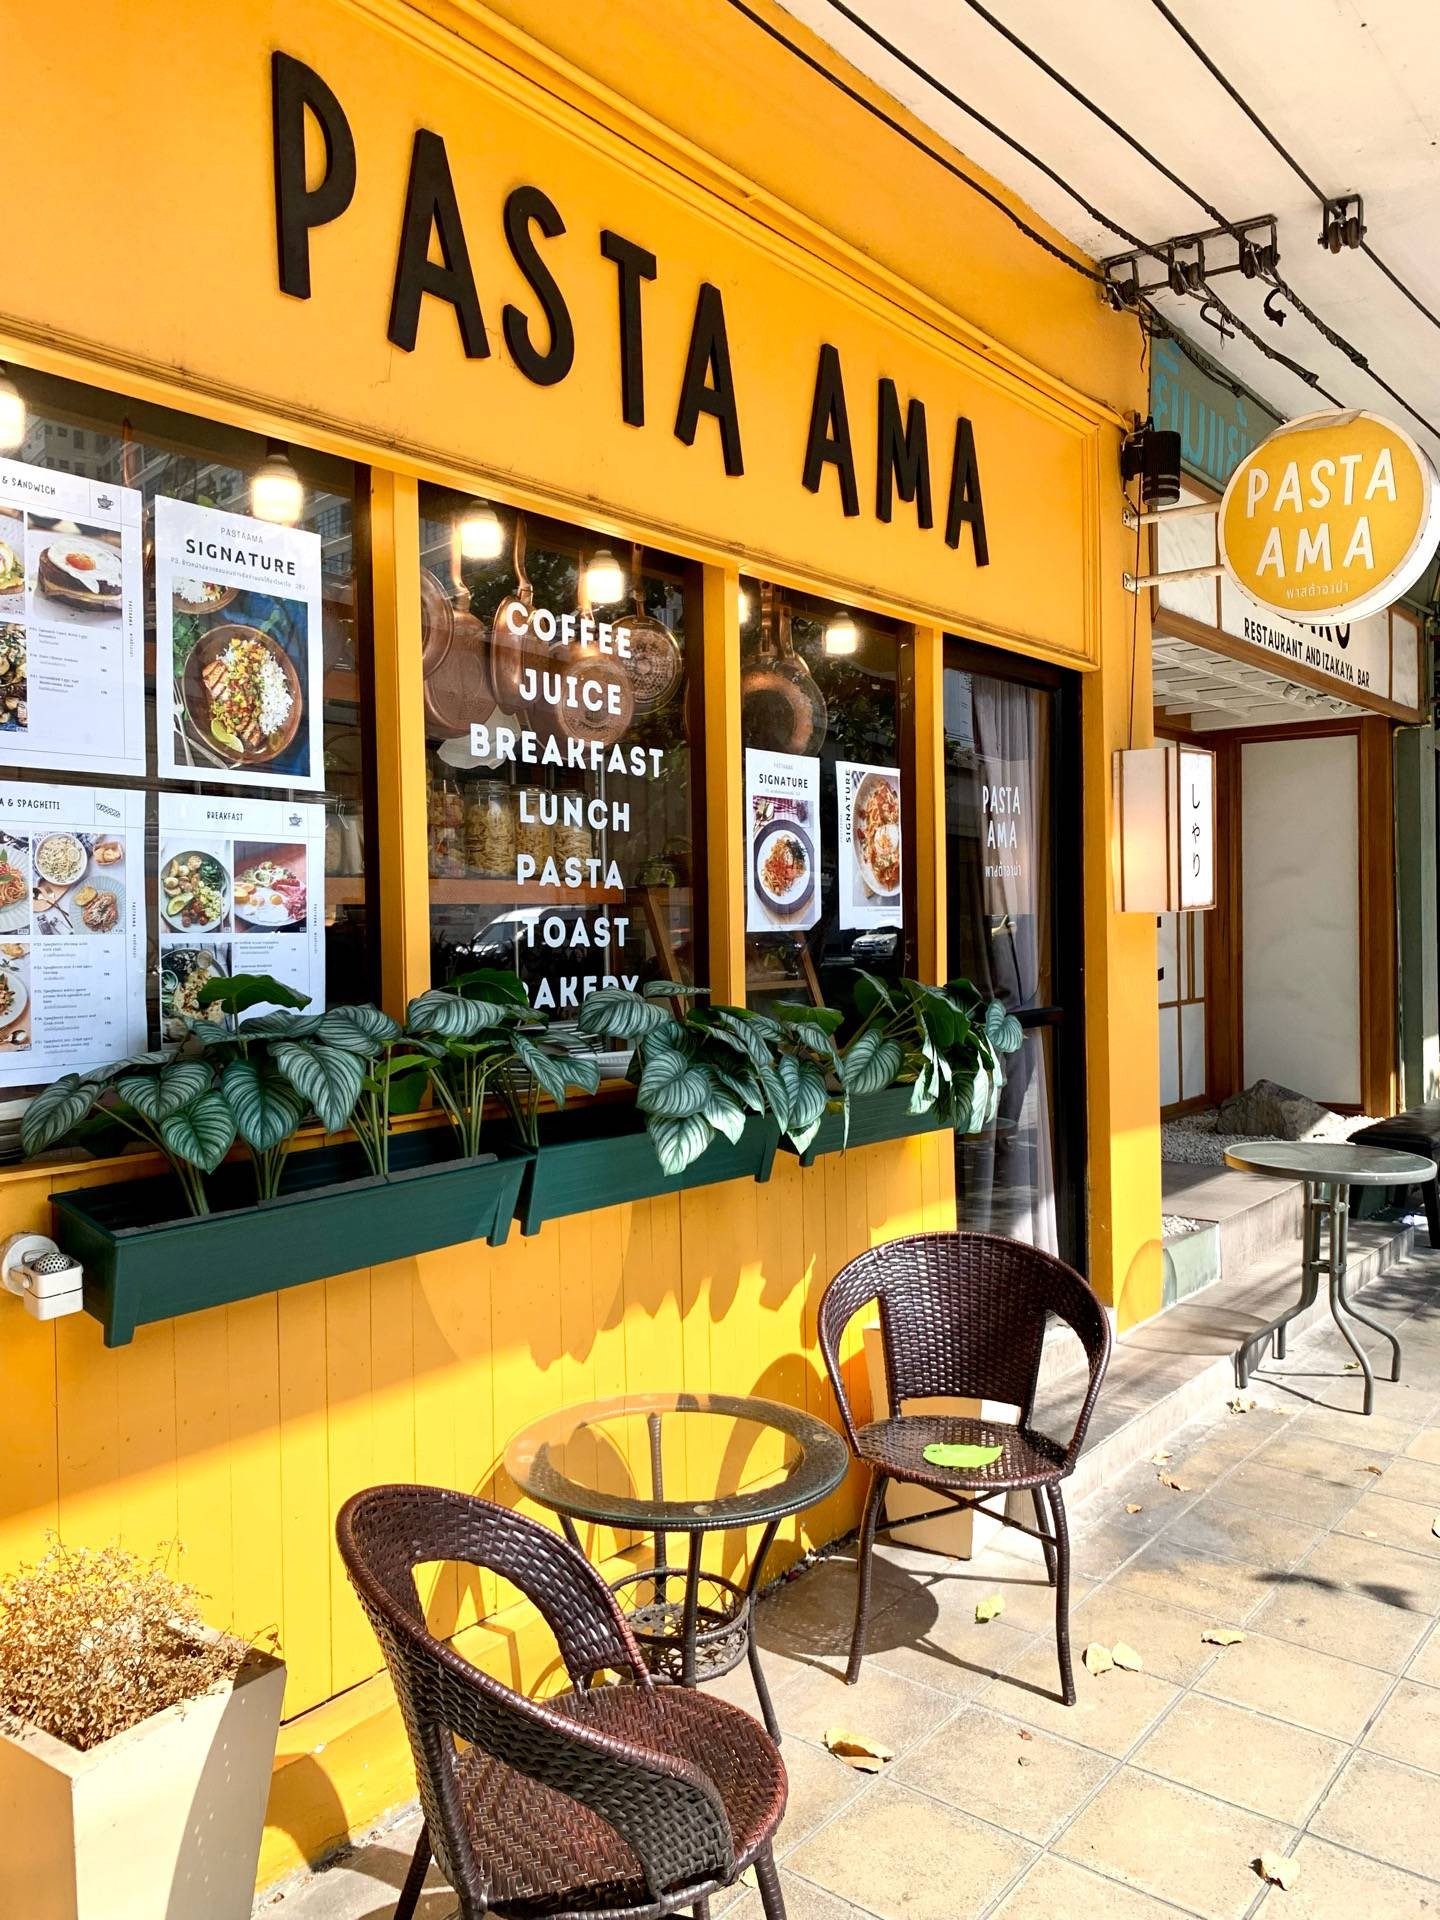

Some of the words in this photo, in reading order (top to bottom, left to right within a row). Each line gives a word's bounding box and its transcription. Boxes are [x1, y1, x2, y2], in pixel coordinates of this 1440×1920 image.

[272, 49, 744, 478] PASTA
[802, 343, 990, 567] AMA
[12, 477, 56, 495] SANDWICH
[1246, 447, 1397, 518] PASTA
[220, 527, 264, 545] PASTAAMA
[1256, 516, 1374, 578] AMA
[186, 538, 296, 576] SIGNATURE
[505, 602, 632, 659] COFFEE
[1244, 617, 1303, 655] RESTAURANT
[1305, 645, 1321, 667] AND
[1322, 652, 1354, 683] IZAKAYA
[1357, 669, 1370, 688] BAR
[518, 668, 622, 716] JUICE
[470, 723, 664, 778] BREAKFAST
[759, 773, 809, 789] SIGNATURE
[7, 798, 14, 807] &
[17, 798, 60, 810] SPAGHETTI
[206, 810, 243, 822] BREAKFAST
[518, 791, 631, 833] LUNCH
[982, 785, 1021, 815] PASTA
[987, 820, 1017, 850] AMA
[517, 854, 624, 891] PASTA
[521, 915, 629, 948] TOAST
